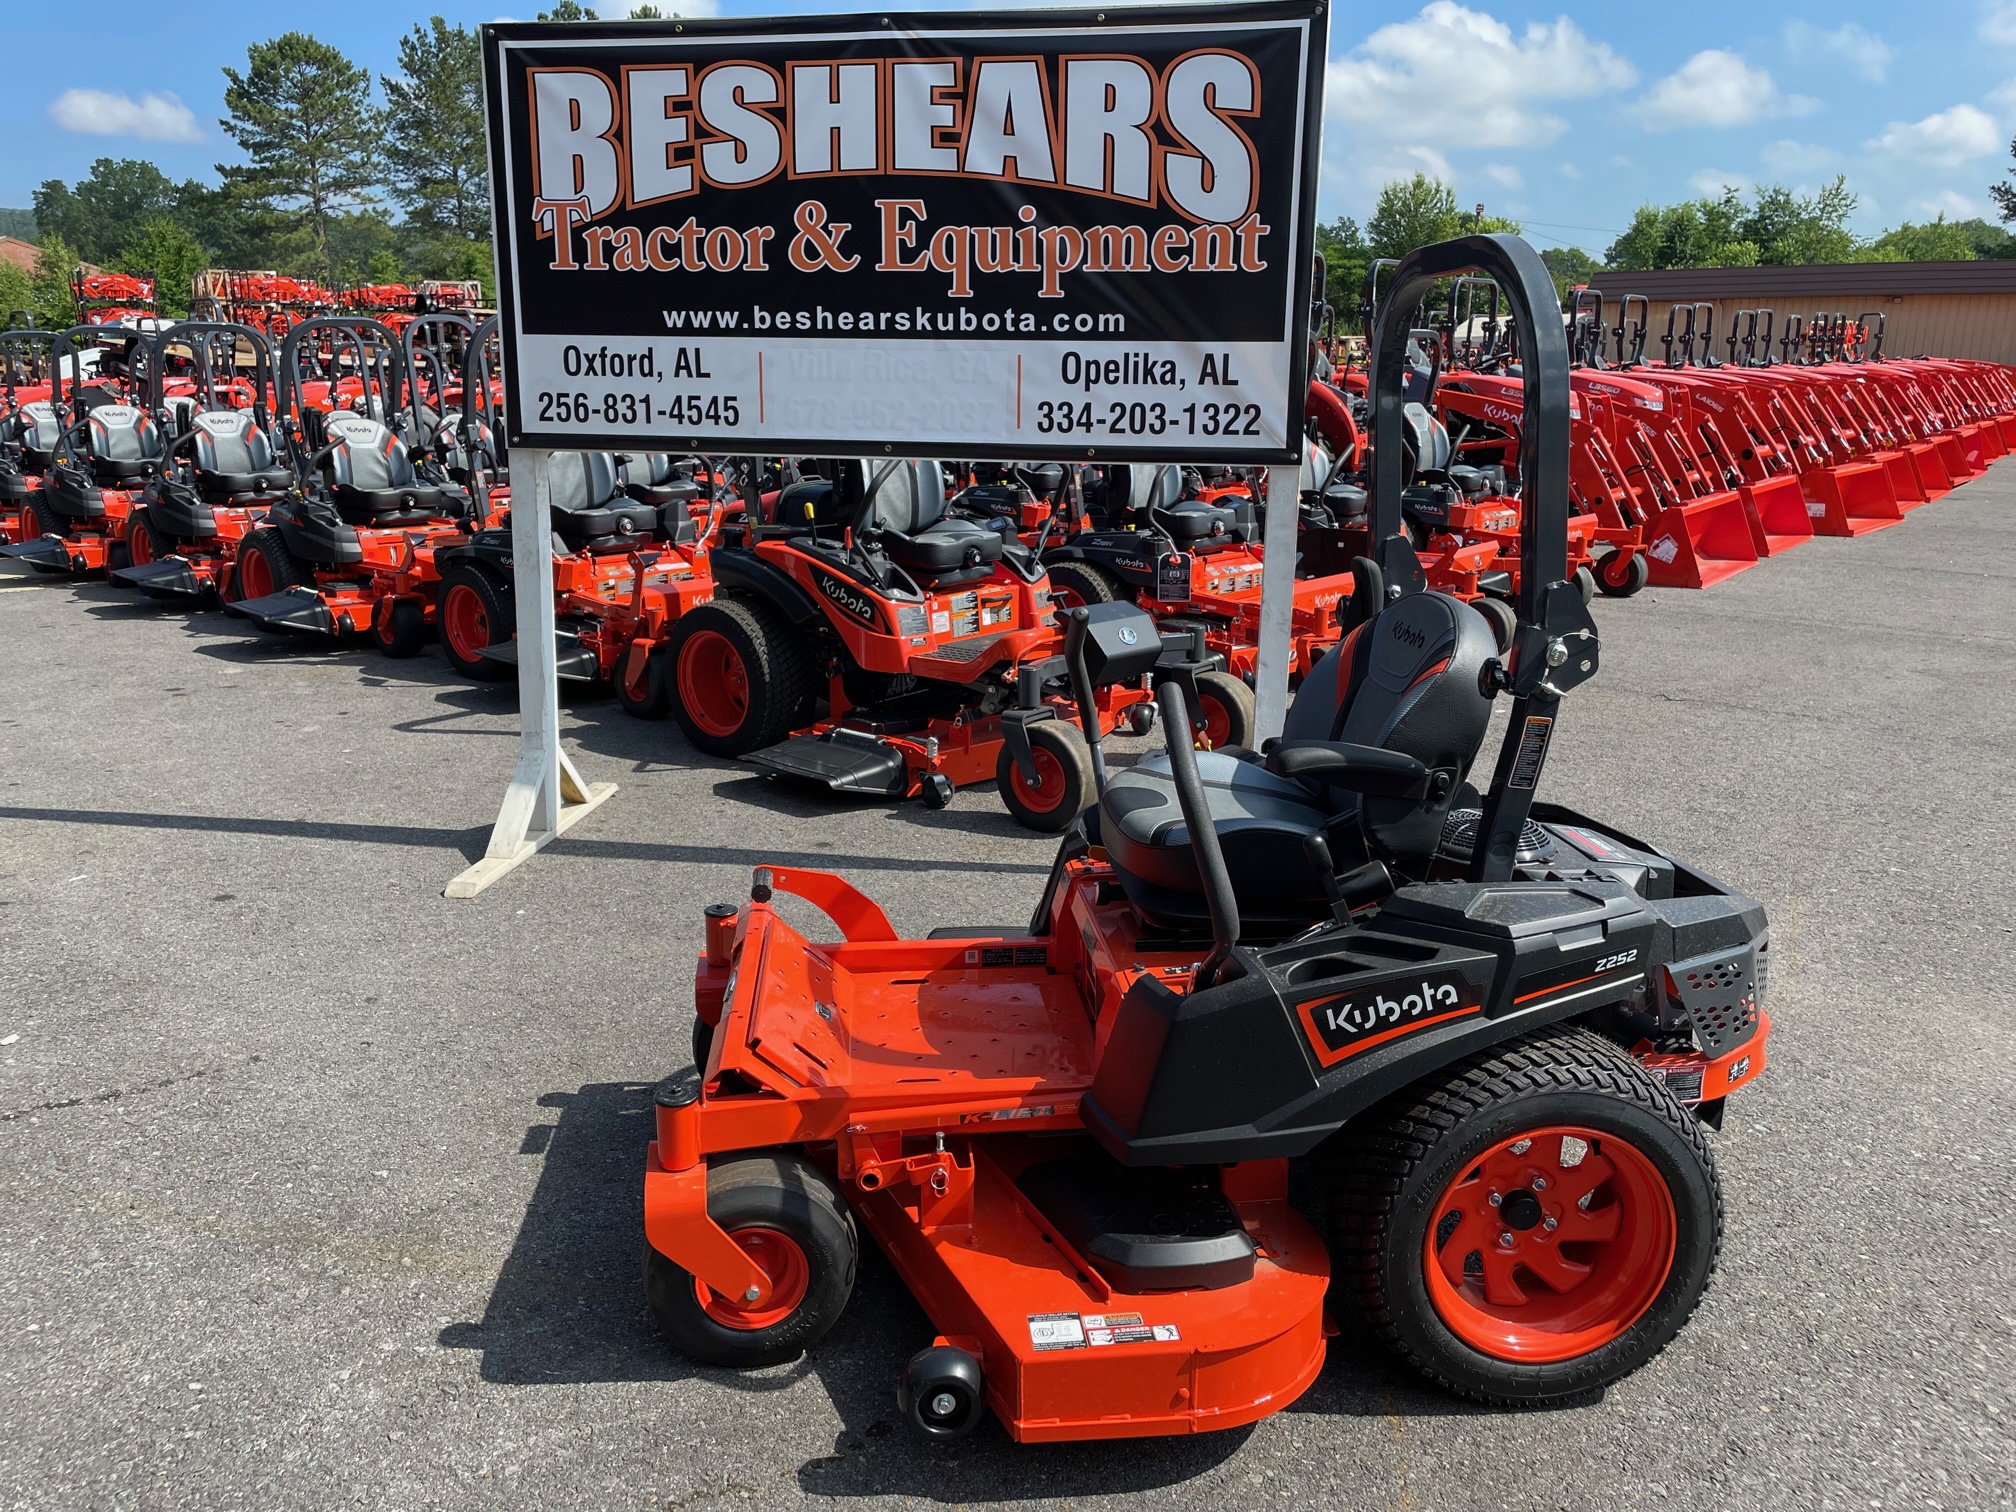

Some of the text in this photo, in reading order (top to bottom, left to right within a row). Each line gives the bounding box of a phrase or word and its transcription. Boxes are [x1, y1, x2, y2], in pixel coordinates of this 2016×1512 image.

[531, 48, 1261, 239] BESHEARS
[532, 195, 1270, 299] Tractor & Equipment
[663, 305, 1127, 333] www.beshearskubota.com
[562, 345, 711, 384] Oxford, AL
[1061, 352, 1239, 392] Opelika, AL
[538, 391, 740, 427] 256-831-4545
[1501, 387, 1524, 398] L35
[346, 426, 371, 434] Kubota
[1037, 401, 1261, 436] 334-203-1322
[1484, 403, 1524, 425] Kubot
[1115, 557, 1144, 568] Kubota
[822, 576, 872, 619] Kubota
[1391, 620, 1426, 650] Kubota
[1594, 949, 1638, 973] Z252
[1326, 981, 1459, 1034] Kubota
